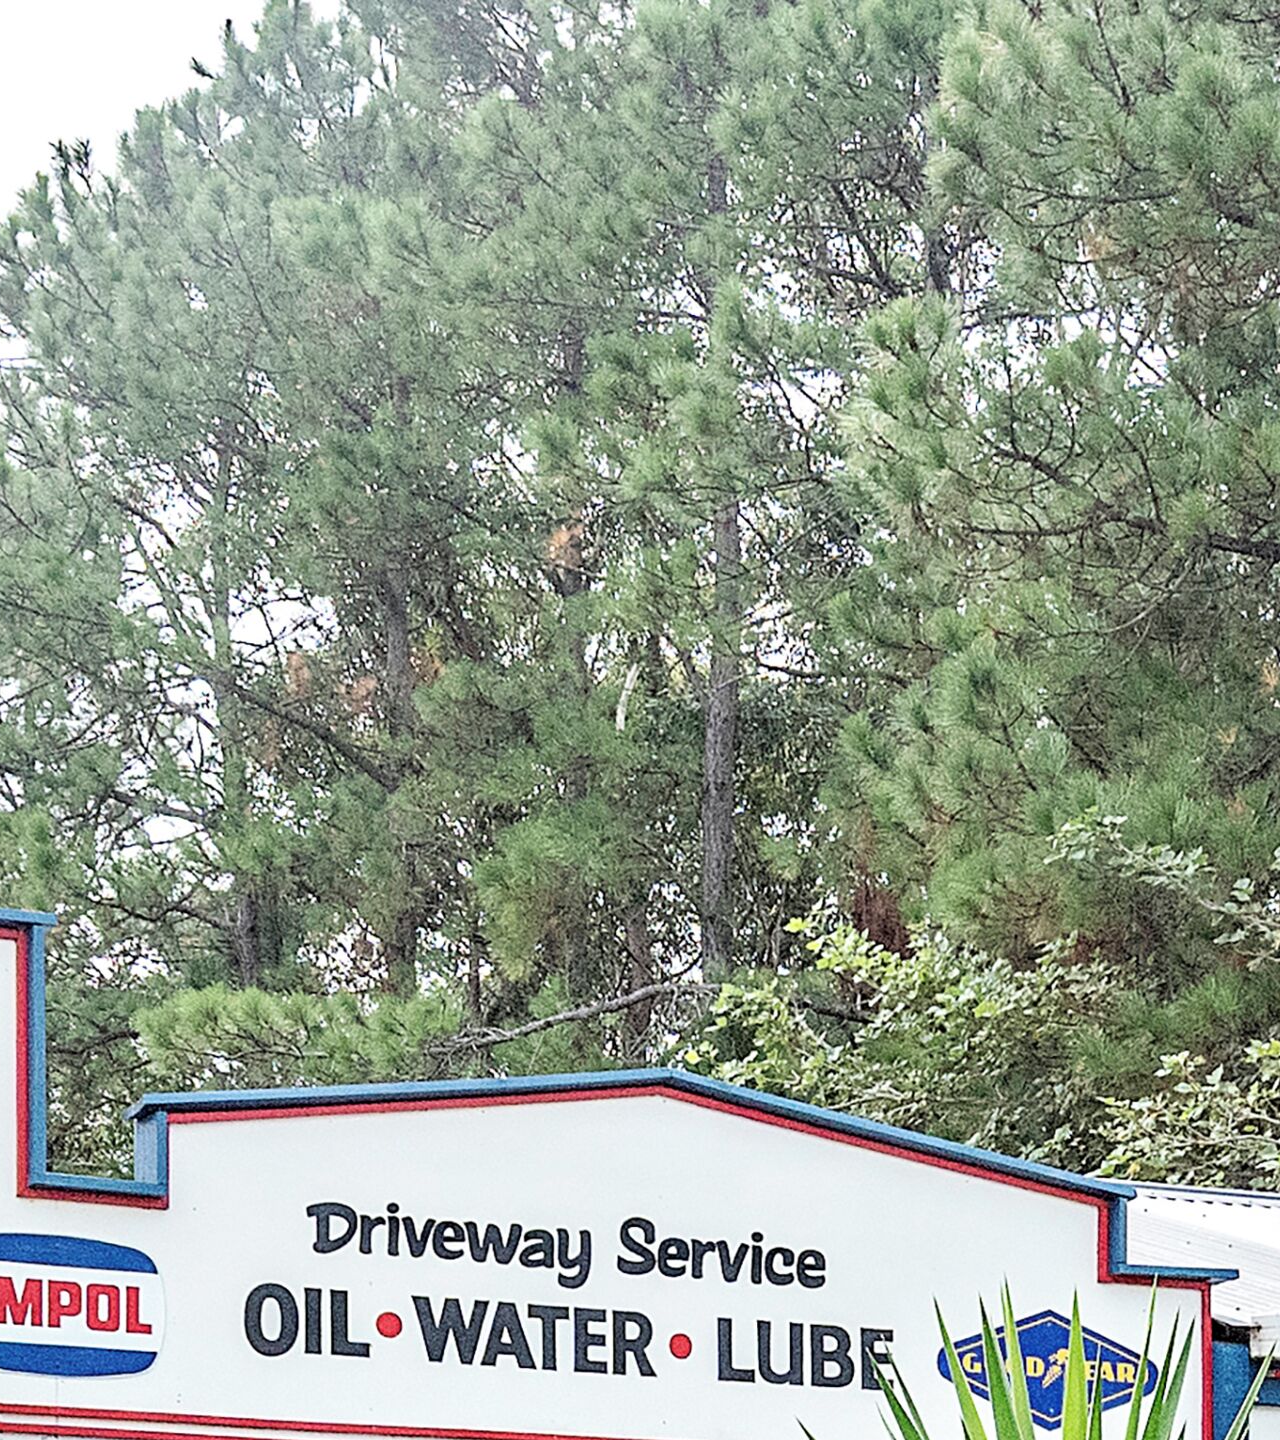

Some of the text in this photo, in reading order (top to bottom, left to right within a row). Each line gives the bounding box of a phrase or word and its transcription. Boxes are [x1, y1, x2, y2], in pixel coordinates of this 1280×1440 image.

[305, 1201, 827, 1289] Driveway Service
[243, 1282, 895, 1391] OIL WATER LUBE
